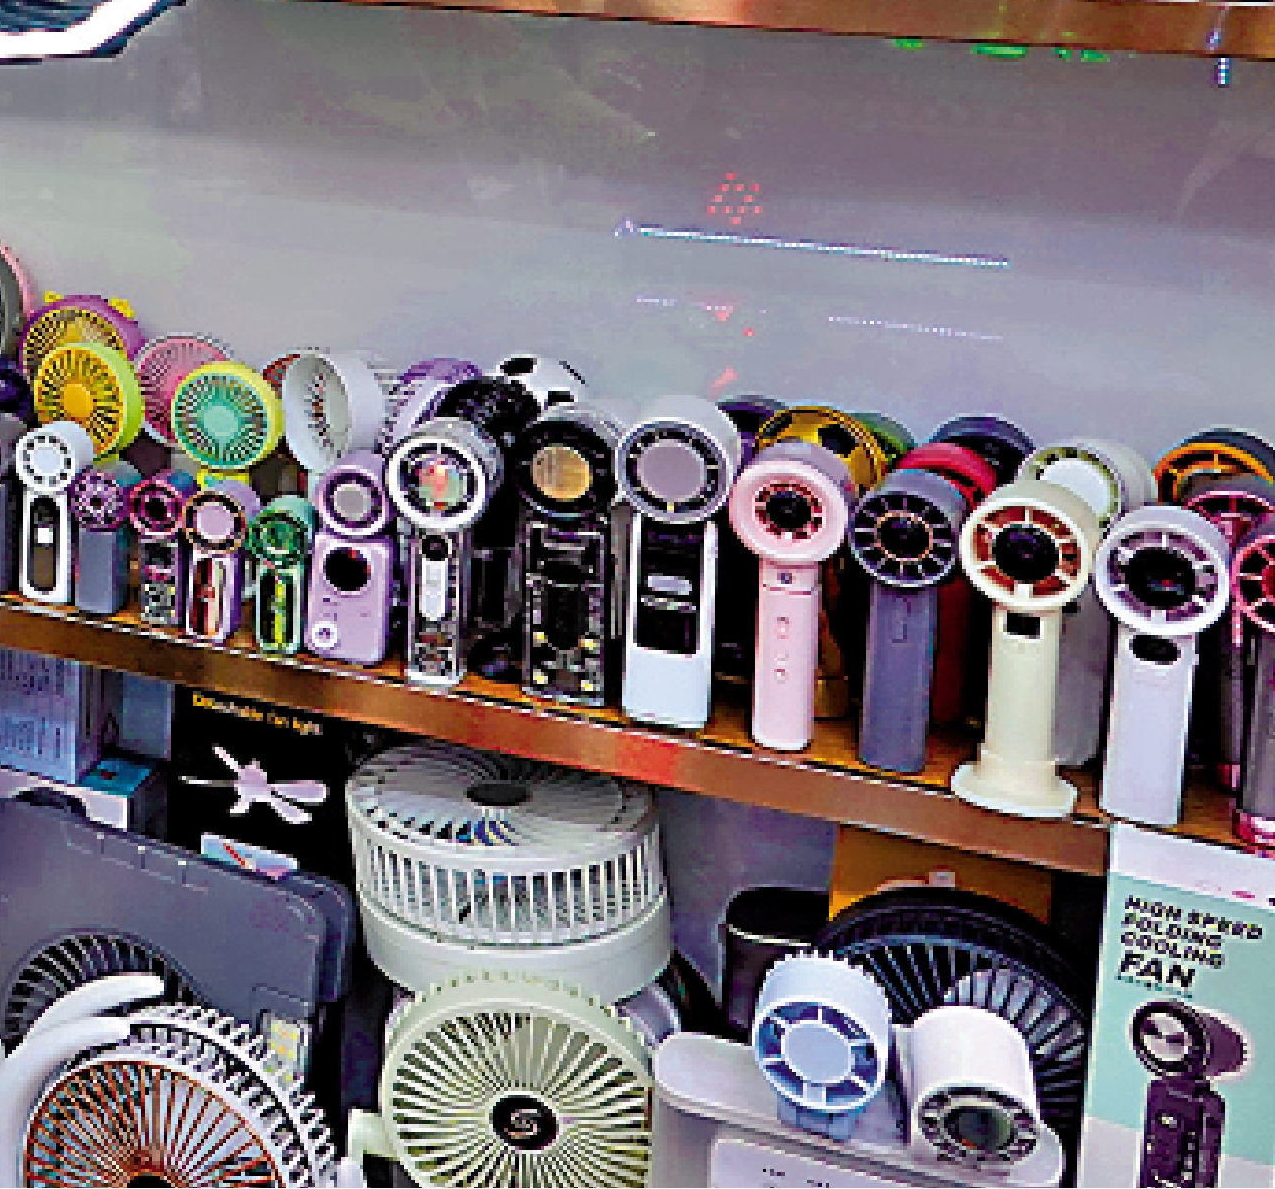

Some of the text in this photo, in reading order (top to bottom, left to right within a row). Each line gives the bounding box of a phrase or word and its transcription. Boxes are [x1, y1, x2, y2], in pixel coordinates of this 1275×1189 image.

[1121, 913, 1222, 947] FOLDING
[1124, 895, 1263, 940] HIGH SPEED
[1120, 950, 1196, 988] FAN
[1121, 932, 1225, 970] COOLING
